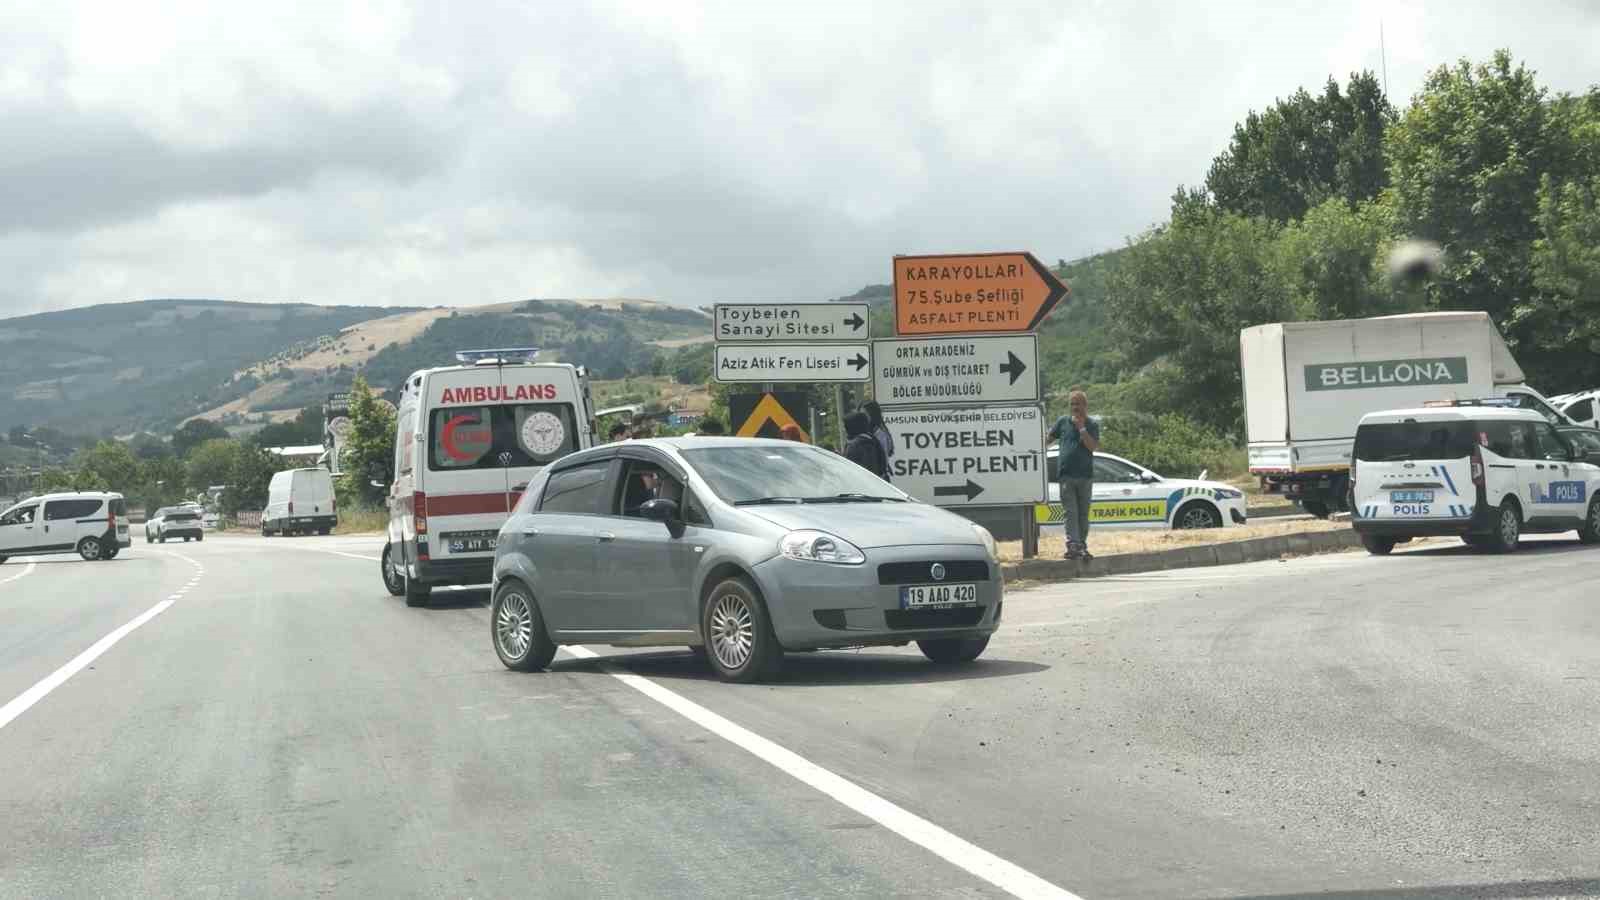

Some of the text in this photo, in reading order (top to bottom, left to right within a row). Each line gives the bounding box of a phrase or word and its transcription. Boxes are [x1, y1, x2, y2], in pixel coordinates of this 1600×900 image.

[906, 264, 1024, 281] KARAYOLLARI
[976, 287, 1025, 305] Şefliği
[721, 307, 800, 322] Toybelen
[908, 307, 1020, 325] ASFALT PLENTİ
[721, 322, 835, 338] Sanayi Sitesi
[896, 343, 976, 358] ORTA KARADENİZ
[721, 356, 841, 369] Aziz Atik Fen Lisesi
[882, 363, 990, 379] GÜMRÜK ve DIŞ TİCARET
[1319, 362, 1452, 386] BELLONA
[440, 384, 557, 404] AMBULANS
[893, 381, 982, 398] BÖLGE MÜDÜRLÜĞÜ
[882, 410, 1036, 424] AMSUN BÜYÜKŞEHİR BELEDİYESİ
[901, 429, 1014, 450] TOYBELEN
[963, 453, 1038, 475] PLENTİ
[1092, 504, 1160, 517] TRAFİK POLİSİ
[910, 588, 924, 603] 19
[928, 586, 950, 603] AAD
[953, 585, 975, 601] 420
